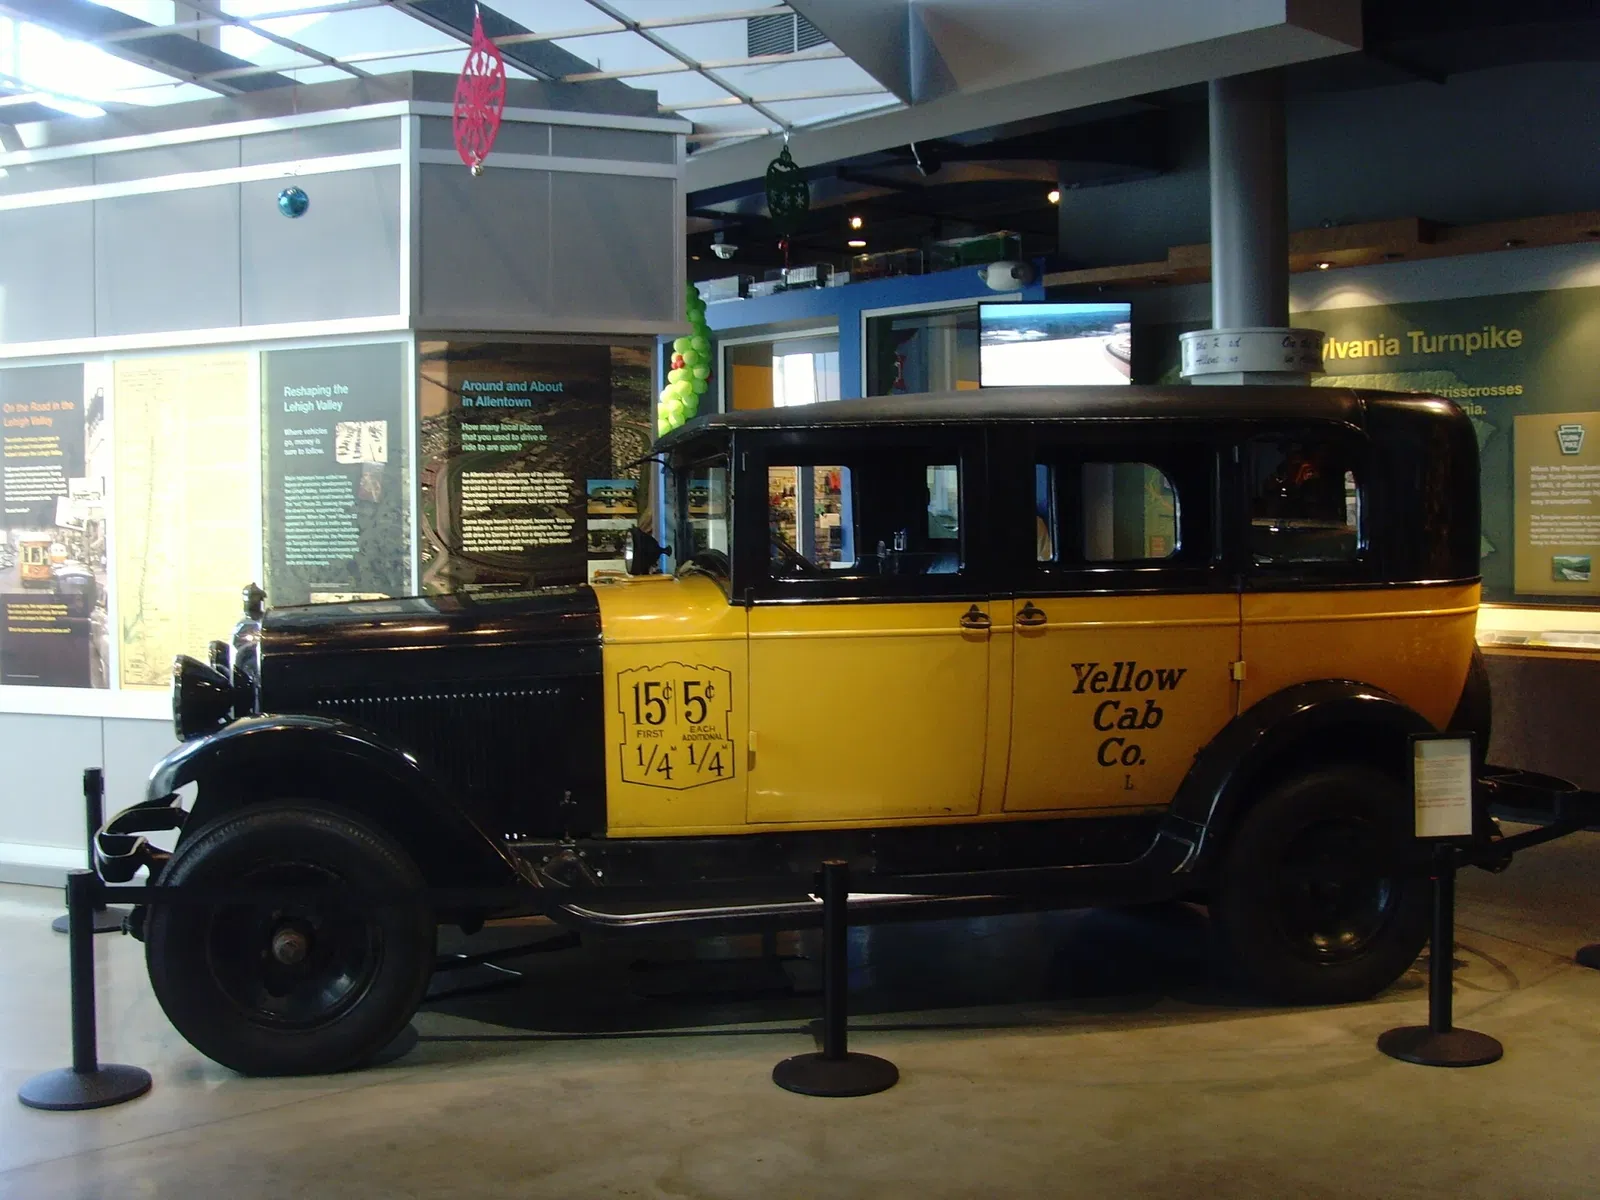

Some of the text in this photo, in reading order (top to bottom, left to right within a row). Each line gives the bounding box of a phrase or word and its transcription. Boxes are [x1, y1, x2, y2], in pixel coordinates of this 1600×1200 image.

[1407, 325, 1522, 356] Turnpike
[284, 384, 348, 397] Reshaping the
[462, 380, 564, 392] Around and About
[284, 400, 343, 413] Lehigh Valley
[462, 395, 532, 408] in Allentown
[1071, 661, 1187, 694] Yellow
[1093, 699, 1163, 731] Cab
[636, 730, 664, 739] FIRST
[689, 725, 716, 734] EACH
[682, 733, 723, 742] ADDITIONAL
[1097, 737, 1146, 767] Co.
